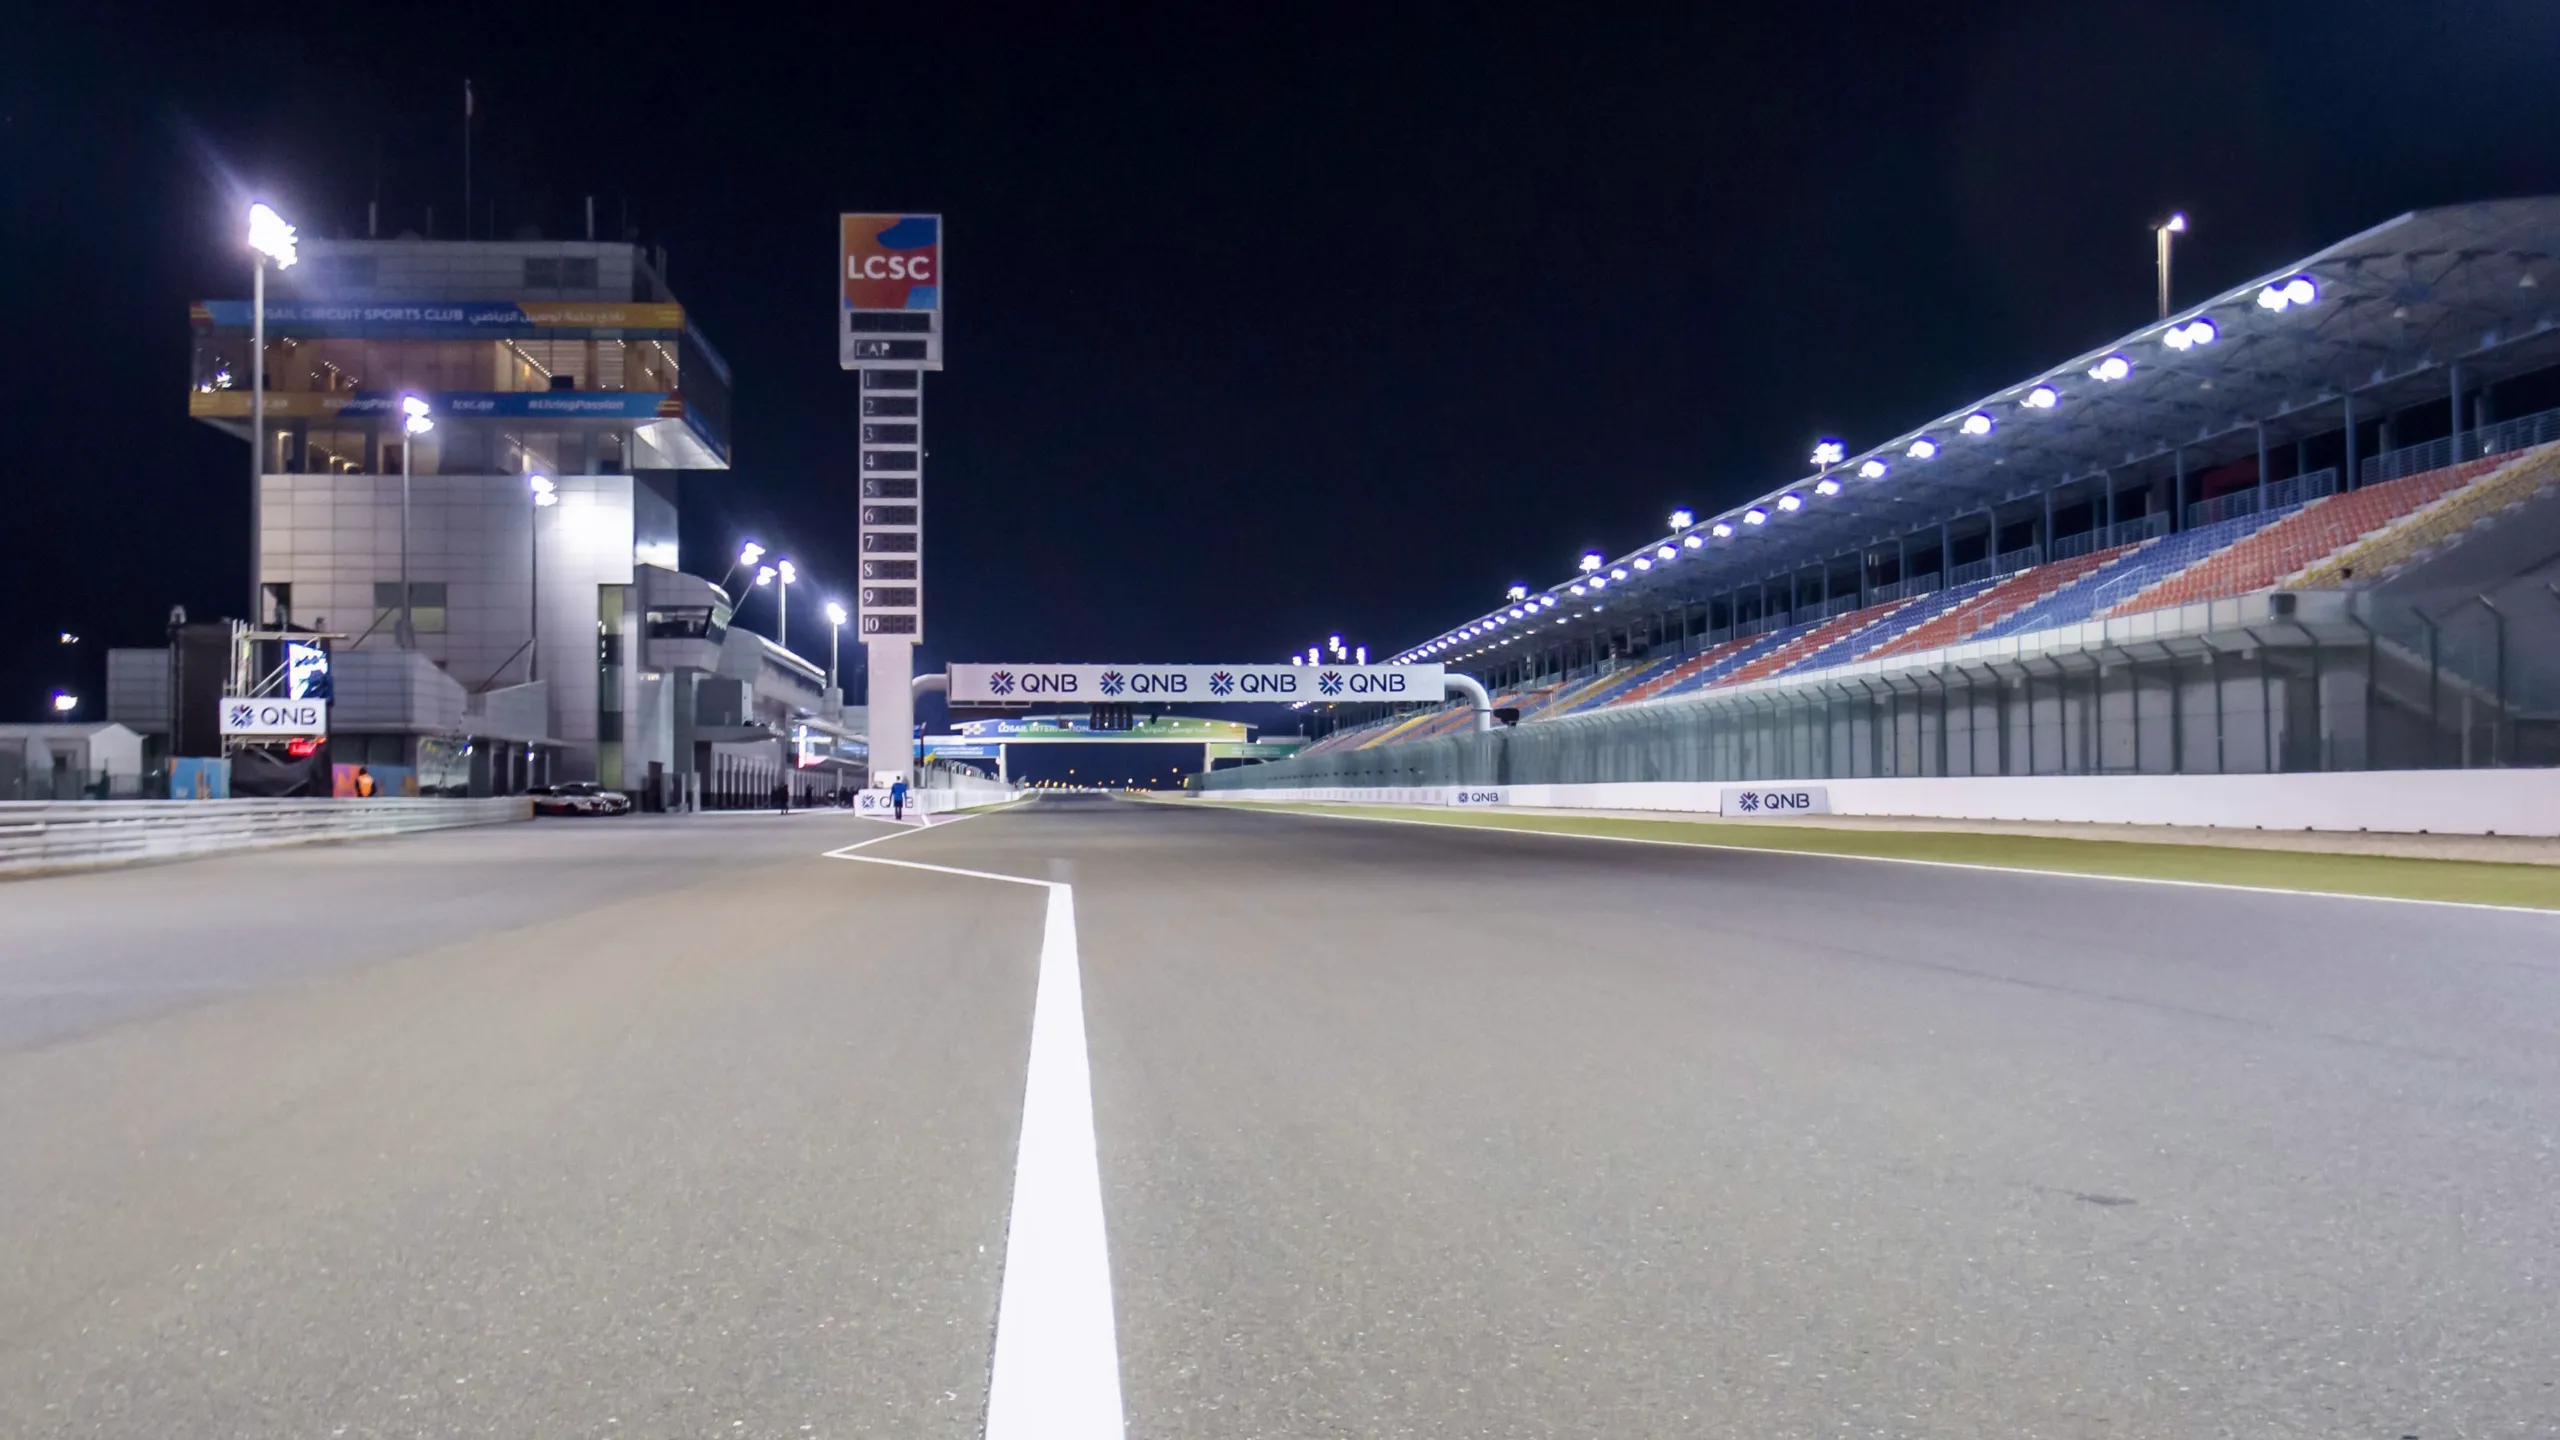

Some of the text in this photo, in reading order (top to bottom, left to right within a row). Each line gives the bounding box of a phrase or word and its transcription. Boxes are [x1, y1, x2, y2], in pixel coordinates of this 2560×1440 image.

[847, 255, 930, 280] LCSC
[247, 308, 464, 321] LSAIL CIRCUIT SPORTS CLUB
[856, 342, 890, 356] LAP
[865, 373, 871, 387] 1
[865, 400, 874, 414] 2
[864, 427, 873, 441] 3
[865, 454, 874, 468] 4
[864, 481, 873, 495] 5
[864, 508, 874, 523] 6
[864, 535, 874, 549] 7
[864, 562, 873, 577] 8
[864, 589, 874, 604] 9
[864, 617, 879, 632] 10
[1021, 673, 1078, 693] QNB
[1131, 673, 1188, 693] QNB
[1240, 673, 1297, 693] QNB
[1349, 673, 1406, 693] QNB
[261, 706, 317, 726] QNB
[879, 795, 914, 809] QB
[1471, 792, 1499, 802] QNB
[1764, 793, 1810, 809] QNB
